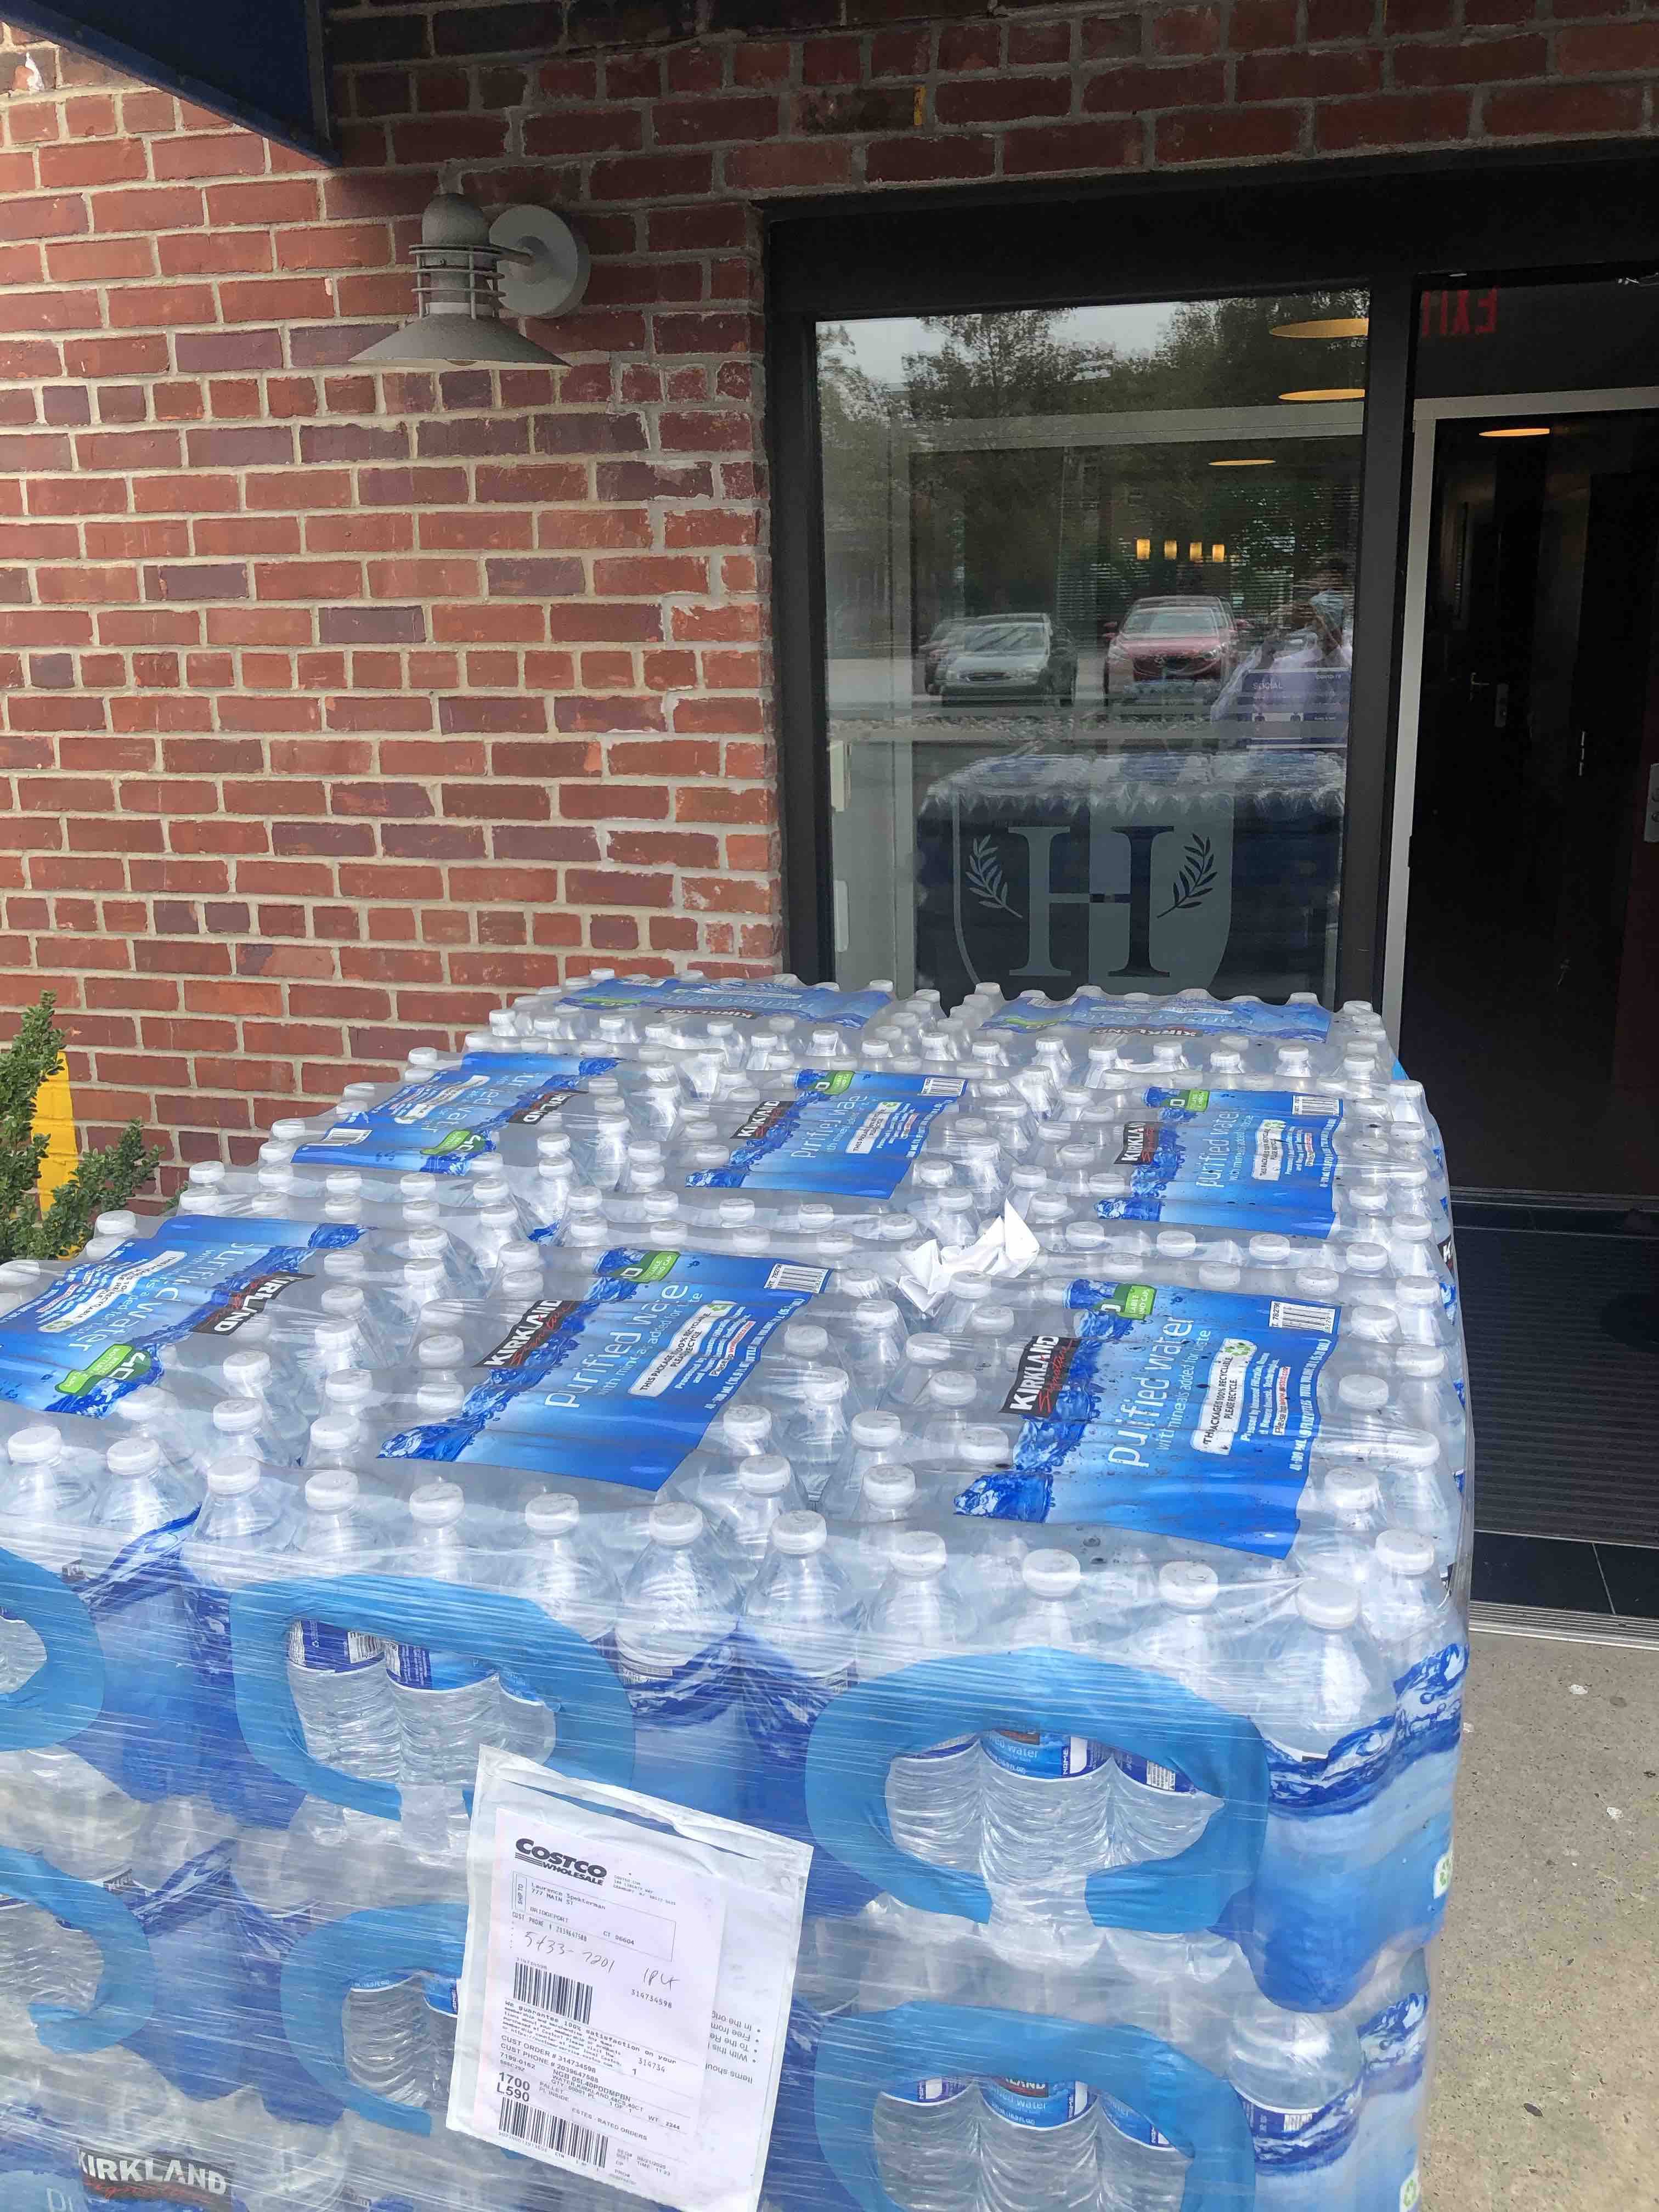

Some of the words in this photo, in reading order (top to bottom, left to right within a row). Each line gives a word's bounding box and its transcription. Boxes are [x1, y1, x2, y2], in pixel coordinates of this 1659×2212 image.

[1251, 680, 1283, 691] SOCIAL
[1008, 826, 1175, 978] H
[544, 1333, 642, 1409] purified
[639, 1376, 656, 1392] THIS
[650, 1352, 676, 1377] PACKAGE
[1010, 1335, 1059, 1414] KIRKLAND
[1177, 1363, 1199, 1391] added
[1215, 1386, 1226, 1402] 100%
[1223, 1401, 1235, 1419] PLEASE
[1108, 1376, 1171, 1468] puified
[1008, 1745, 1039, 1759] water
[515, 1838, 607, 1878] COSTCO
[542, 1861, 604, 1886] WHOLESALE
[531, 1888, 543, 1897] 777
[545, 1893, 563, 1903] MAIN
[512, 1911, 525, 1921] CUST
[529, 1917, 544, 1928] PHONE
[603, 1930, 612, 1938] CT
[615, 1934, 635, 1946] 06604
[631, 1989, 673, 2009] 314734598
[728, 2018, 741, 2028] the
[743, 2022, 752, 2031] In
[504, 2000, 514, 2008] We
[518, 2005, 559, 2024] guarantee
[585, 2028, 640, 2052] satisfaction
[644, 2050, 654, 2058] on
[657, 2054, 676, 2066] your
[724, 2037, 736, 2047] the
[731, 2029, 751, 2041] Free
[500, 2042, 521, 2055] CUST
[522, 2050, 549, 2066] PHONE
[501, 2034, 521, 2047] CUST
[523, 2042, 550, 2057] ORDER
[557, 2055, 596, 2074] 314734598
[712, 2044, 726, 2055] this
[729, 2049, 747, 2062] With
[739, 2042, 749, 2051] To
[500, 2071, 531, 2091] 1700
[730, 2070, 753, 2084] Items
[498, 2082, 530, 2102] L590
[647, 2114, 659, 2123] WT
[78, 2152, 227, 2195] KIRKLAND
